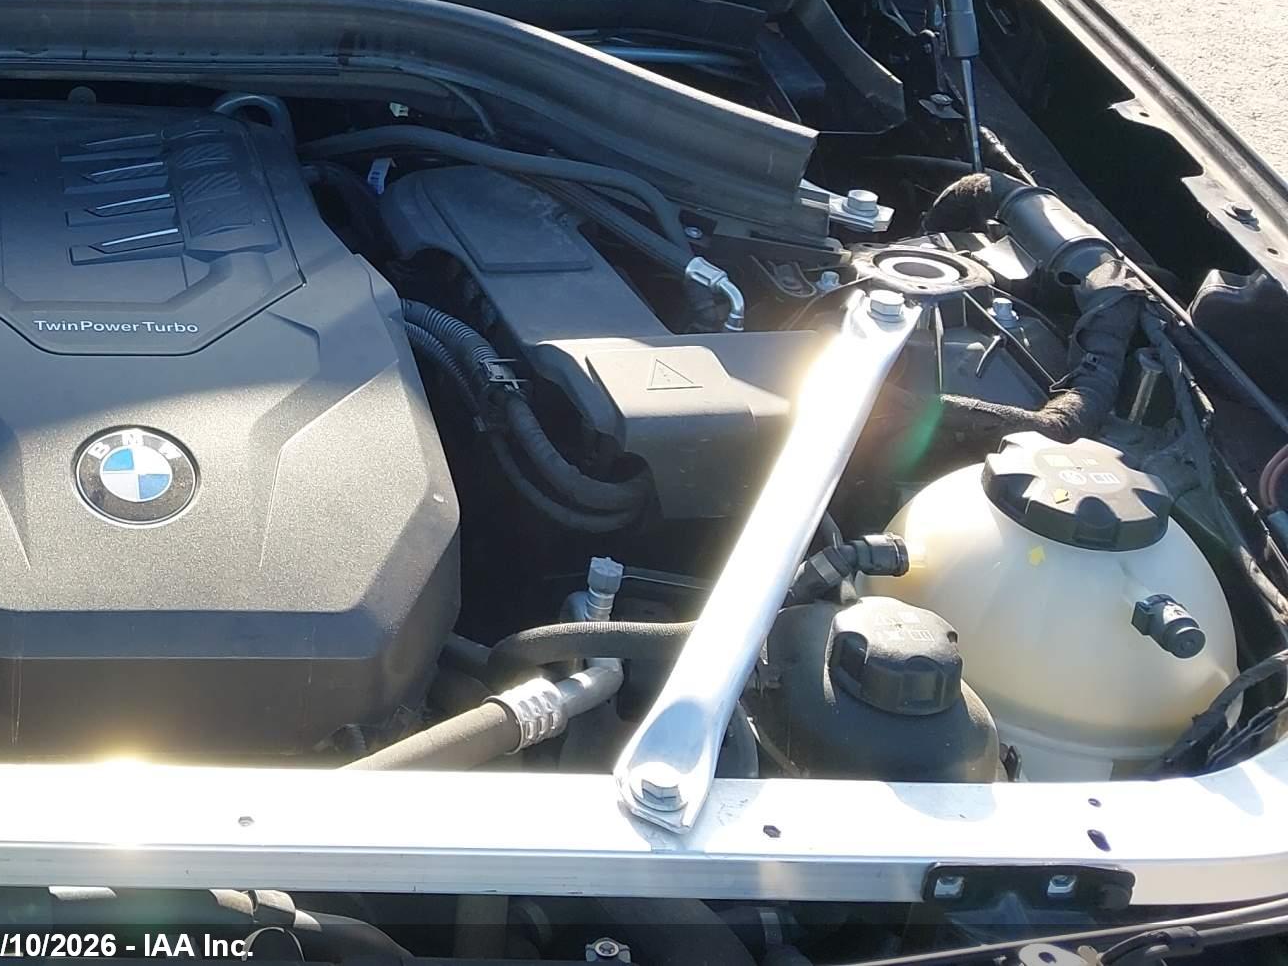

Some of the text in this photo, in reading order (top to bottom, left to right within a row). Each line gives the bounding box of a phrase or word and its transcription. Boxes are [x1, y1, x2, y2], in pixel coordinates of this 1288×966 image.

[34, 320, 199, 333] TwinPower Turbo
[88, 433, 182, 460] BMW
